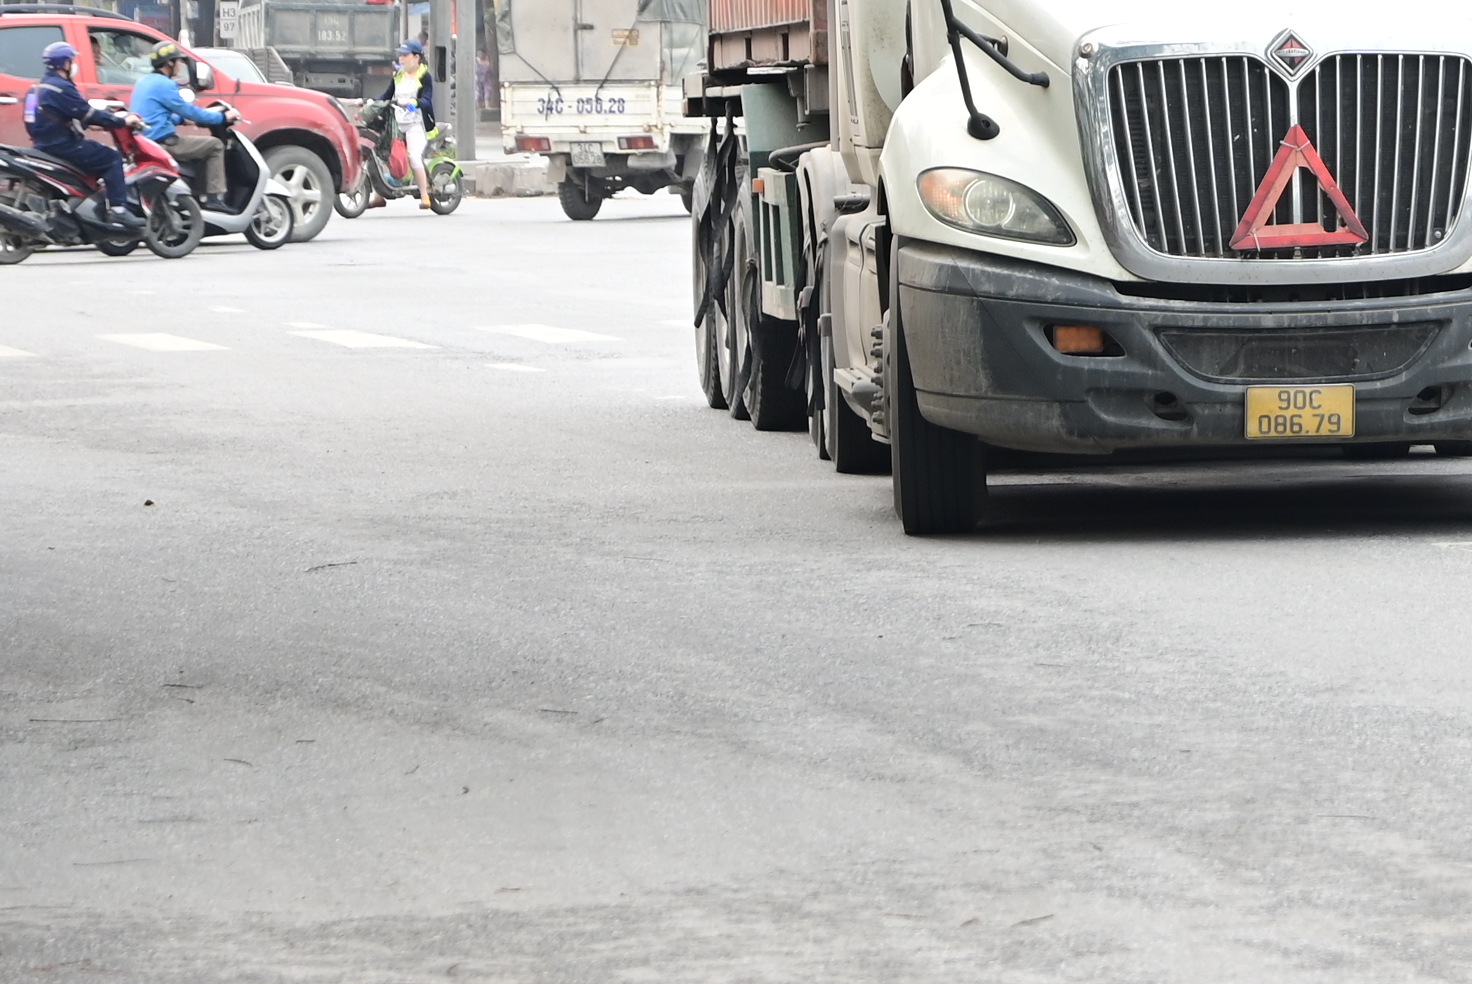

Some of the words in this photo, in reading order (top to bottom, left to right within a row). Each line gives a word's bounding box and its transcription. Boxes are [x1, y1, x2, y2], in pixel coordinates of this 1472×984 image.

[222, 7, 236, 18] H3
[223, 22, 235, 32] 97
[1277, 389, 1322, 411] 90C
[1258, 413, 1342, 435] 086.79
